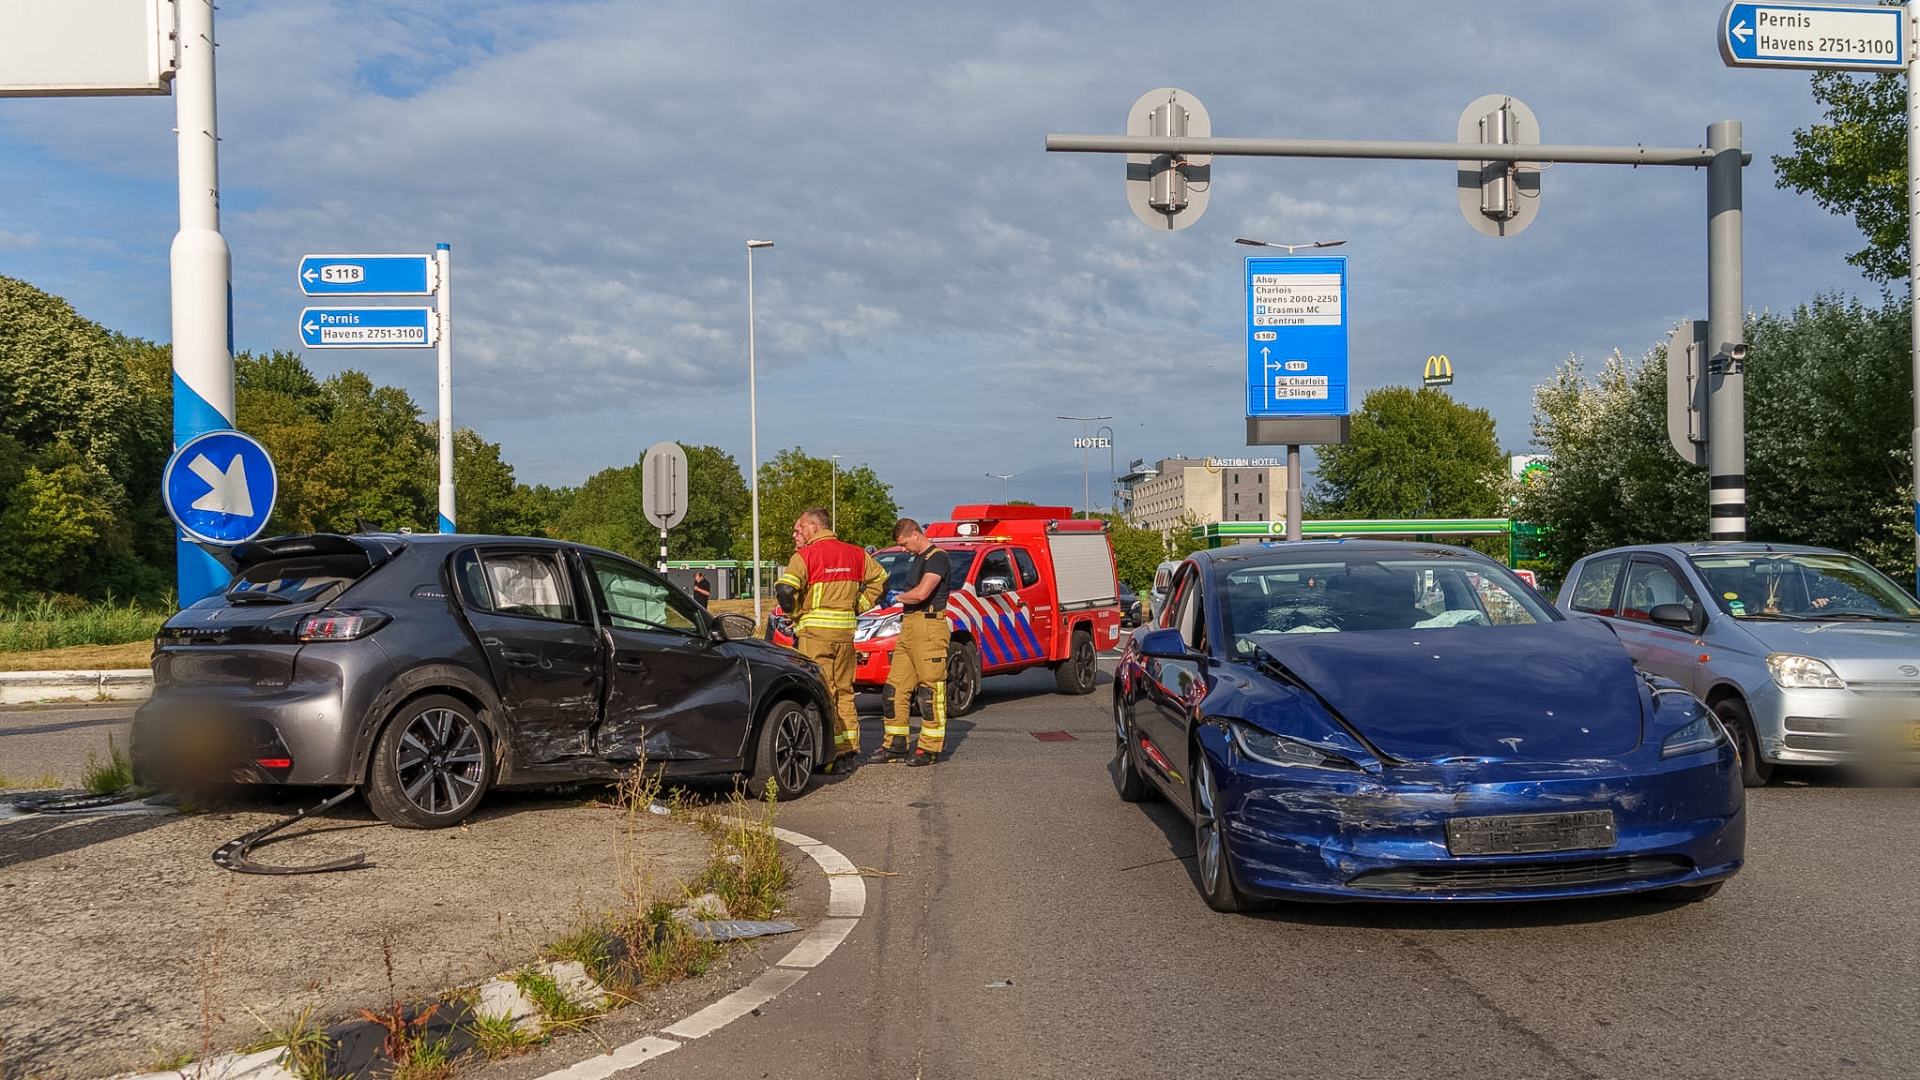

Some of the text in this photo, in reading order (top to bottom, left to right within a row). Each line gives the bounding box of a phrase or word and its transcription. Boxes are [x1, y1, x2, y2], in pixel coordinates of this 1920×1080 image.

[1759, 12, 1811, 28] Pernis
[1760, 36, 1894, 54] Havens 2751-3100
[325, 269, 359, 279] S 118
[1255, 276, 1278, 285] Ahoy
[1290, 295, 1338, 303] 2000-2250
[1268, 306, 1304, 314] Erasmus
[1306, 306, 1320, 314] MC
[320, 313, 360, 324] Pernis
[1268, 317, 1305, 325] Centrum
[324, 328, 423, 339] Havens 2751-3100
[1289, 389, 1317, 398] Slinge
[1074, 437, 1111, 448] HOTEL
[1211, 458, 1280, 467] BASTION HOTEL
